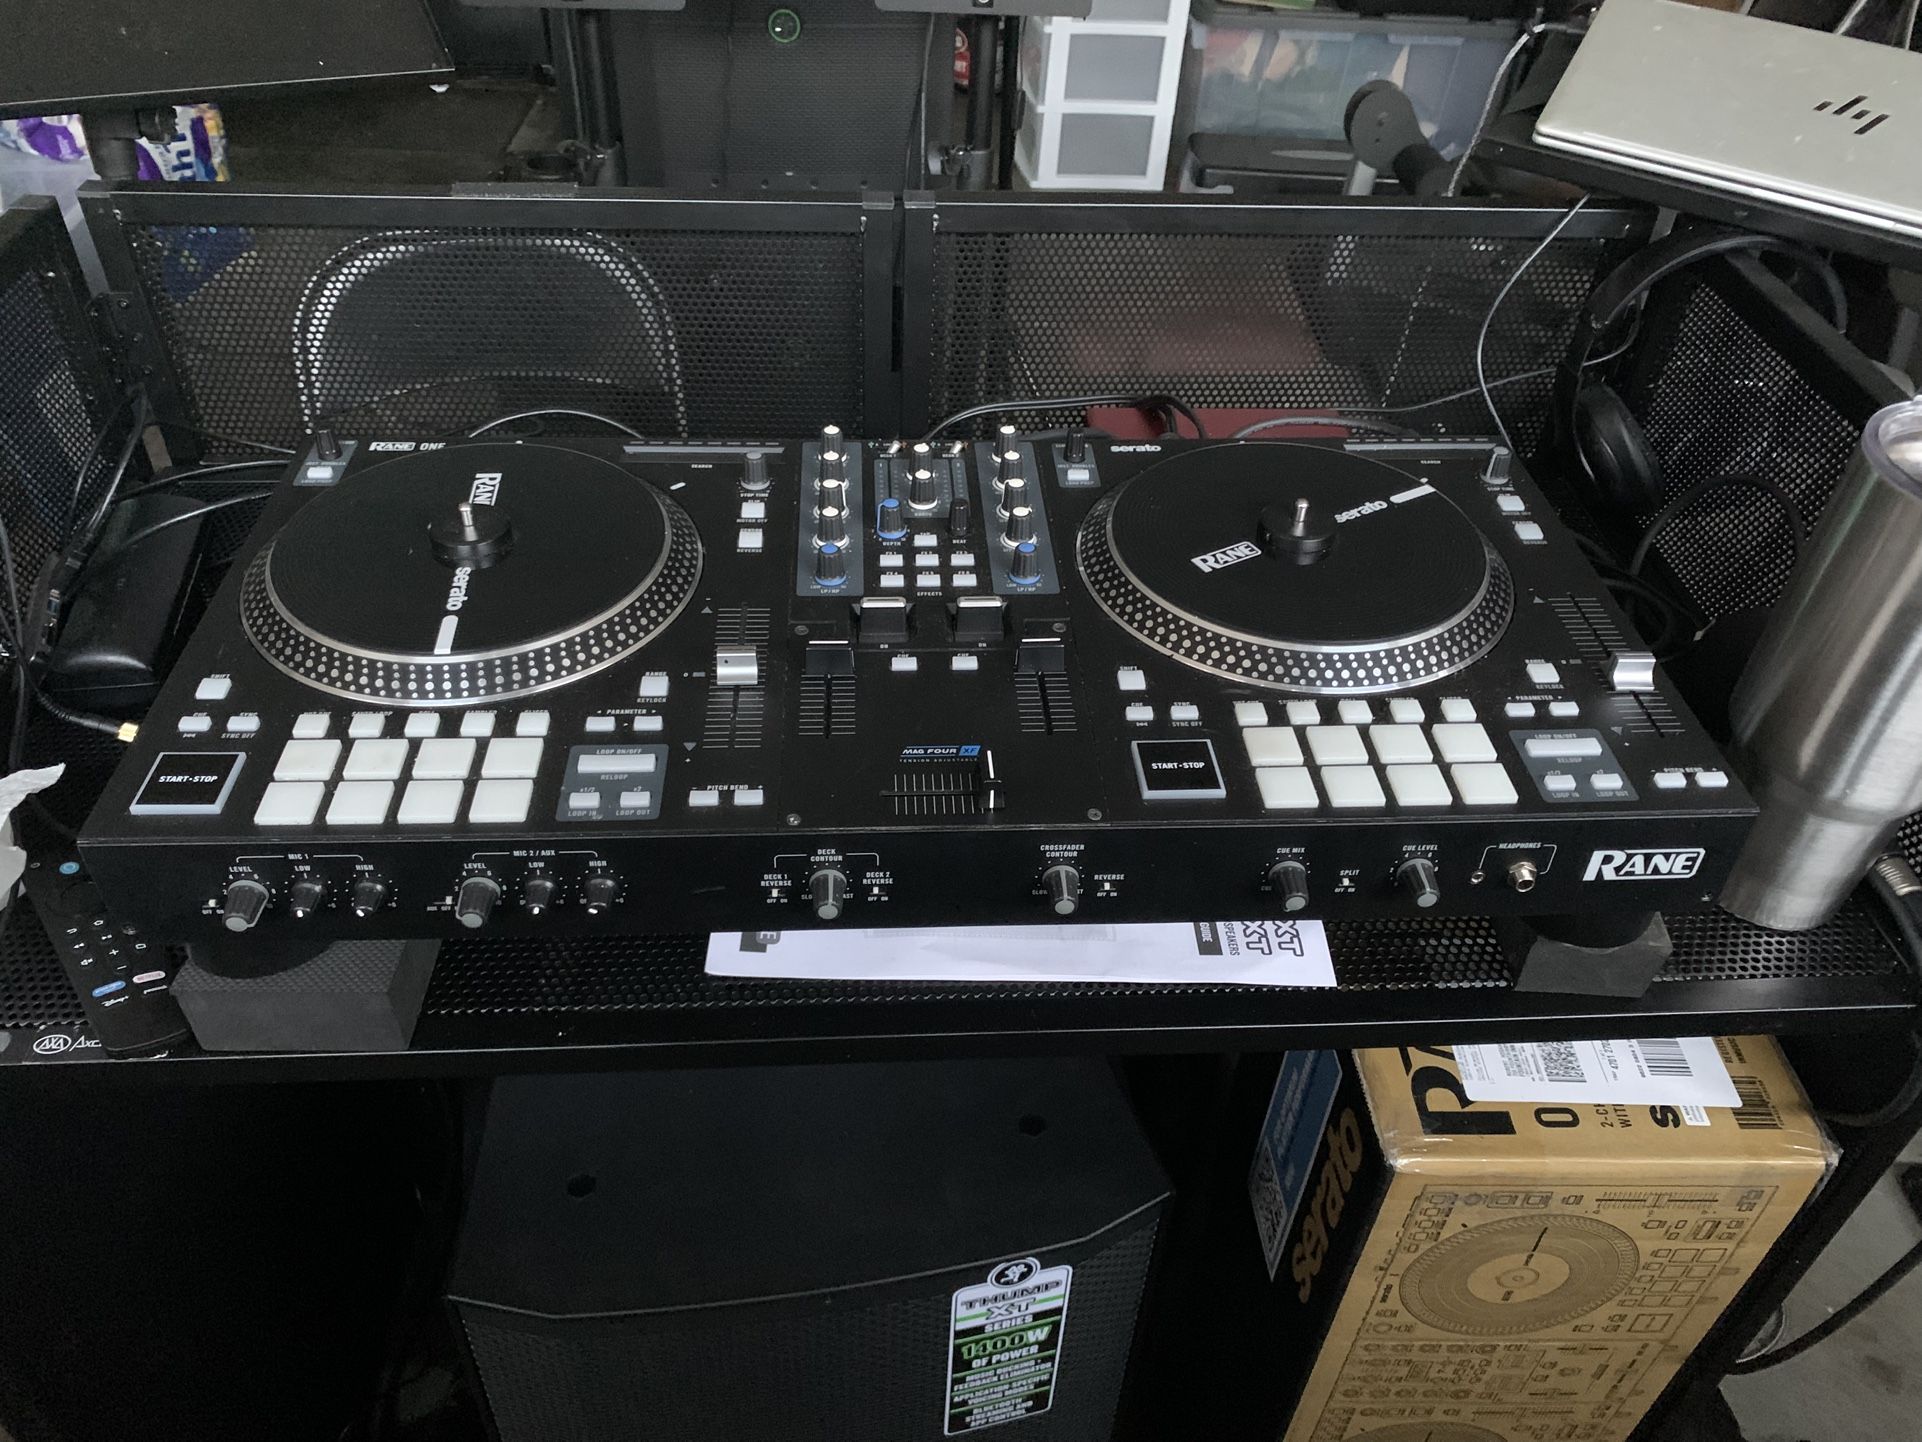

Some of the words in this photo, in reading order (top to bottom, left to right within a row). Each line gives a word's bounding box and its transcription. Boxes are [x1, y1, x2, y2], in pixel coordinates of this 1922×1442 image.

[369, 442, 416, 451] RANE
[1110, 444, 1162, 452] serato
[470, 473, 502, 506] RAN
[1334, 500, 1388, 524] serato
[1191, 541, 1262, 573] RANE
[446, 567, 471, 611] serato
[1582, 848, 1706, 882] RANE
[1200, 922, 1213, 943] GUIDE
[1224, 922, 1240, 956] SPEAKERS
[1292, 1107, 1363, 1304] serato
[961, 1280, 1063, 1310] THUMP
[986, 1297, 1036, 1320] XT
[984, 1315, 1033, 1333] SERIES
[961, 1324, 1052, 1359] 1400W
[972, 1357, 990, 1368] OF
[992, 1345, 1039, 1364] POWER
[1000, 1362, 1052, 1380] ELIMINATOR
